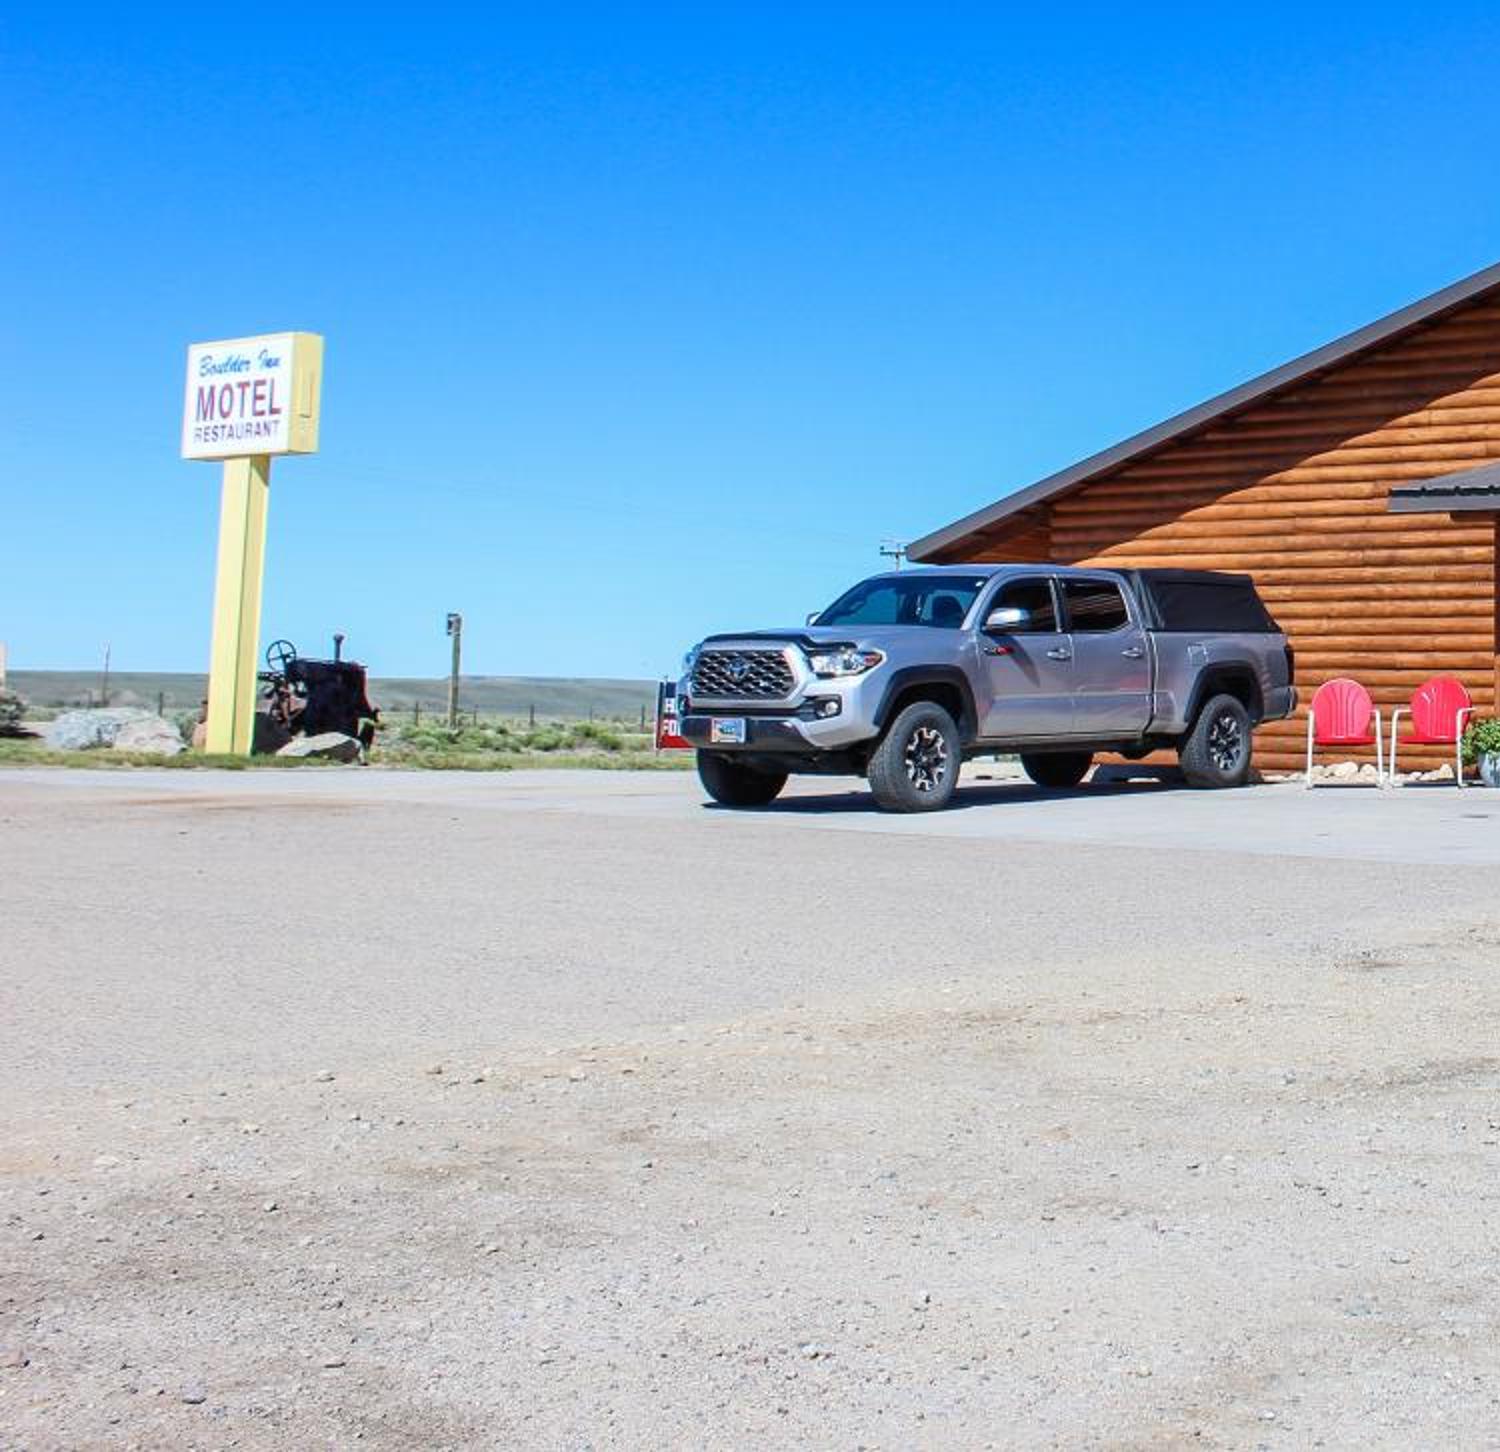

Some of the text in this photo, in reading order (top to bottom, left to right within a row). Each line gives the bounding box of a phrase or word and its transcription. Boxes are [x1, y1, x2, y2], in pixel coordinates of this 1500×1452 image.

[200, 348, 281, 377] Boulder Inn
[196, 377, 282, 422] MOTEL
[193, 419, 282, 443] RESTAURANT
